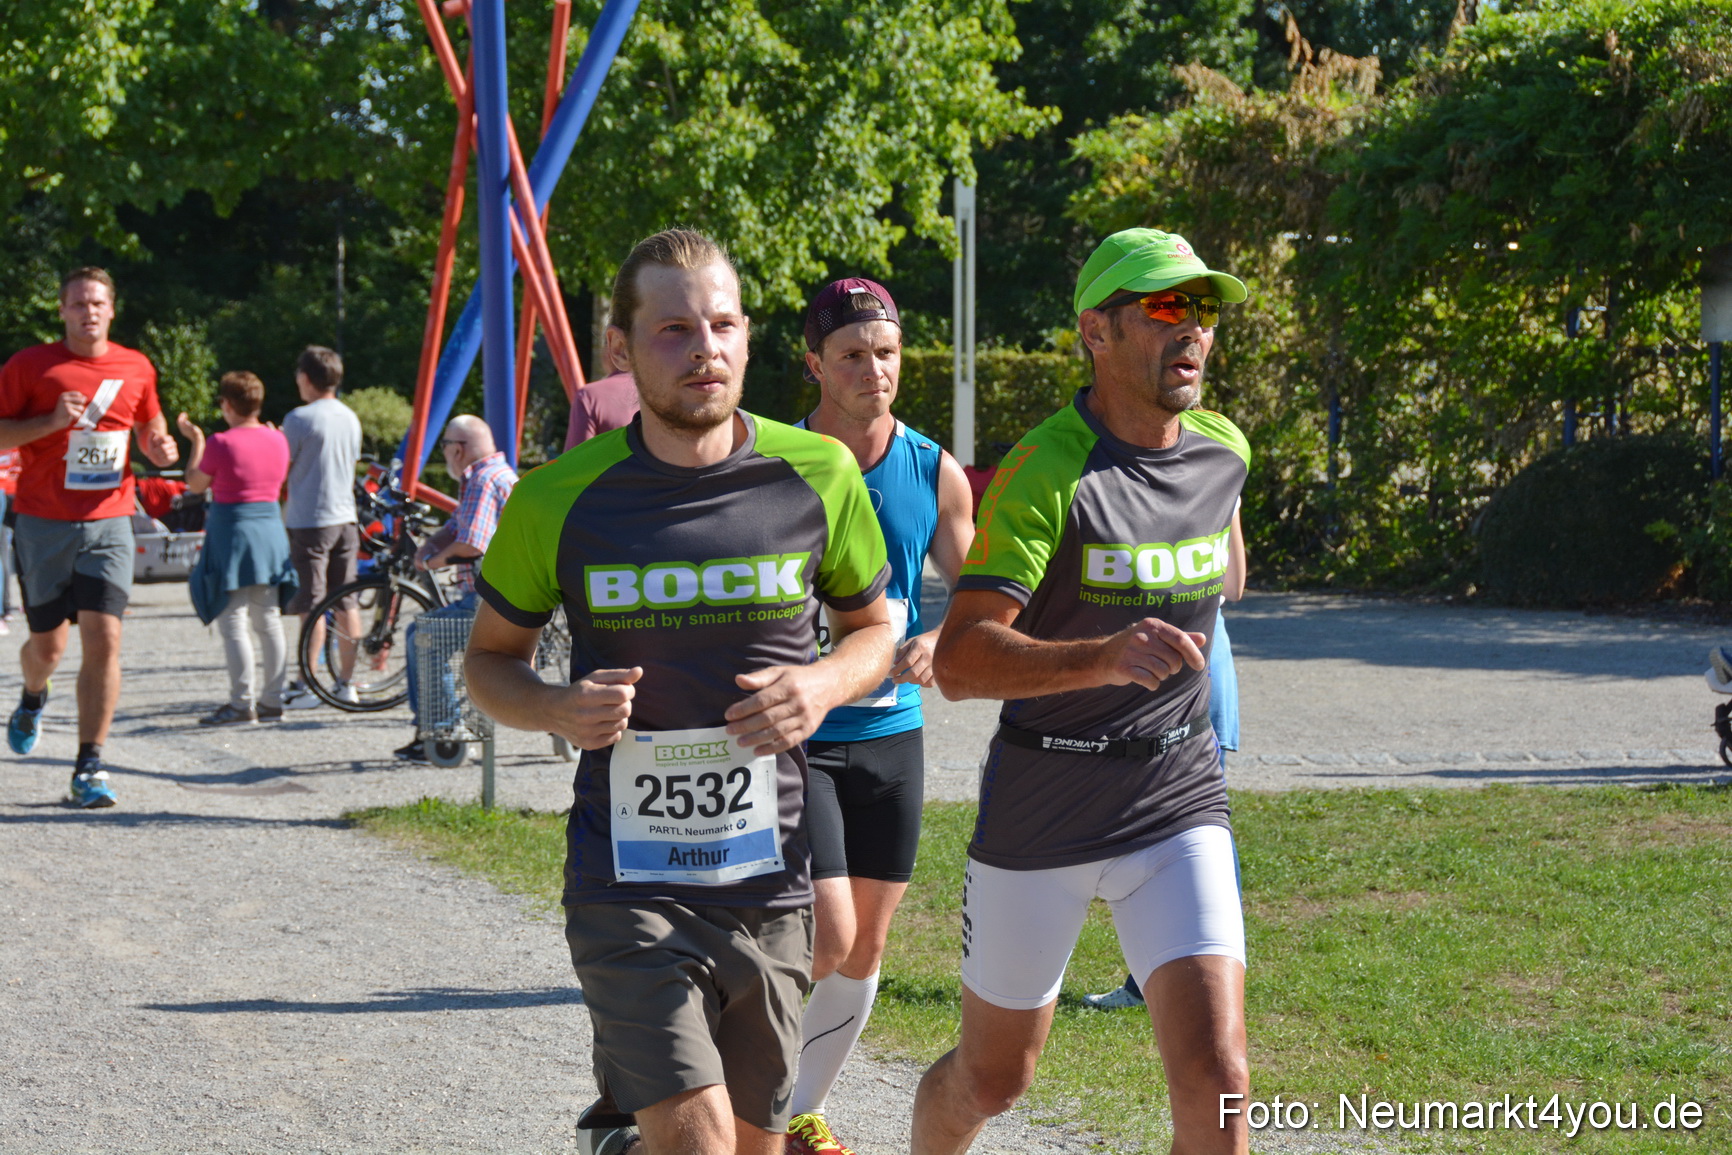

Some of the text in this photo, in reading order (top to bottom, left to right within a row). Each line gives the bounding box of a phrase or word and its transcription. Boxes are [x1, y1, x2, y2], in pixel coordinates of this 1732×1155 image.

[78, 447, 119, 465] 2614
[1082, 527, 1231, 588] BOCK
[585, 553, 810, 612] BOCK
[1079, 581, 1225, 608] inspired by smart con
[592, 603, 805, 632] inspired by smart concepts
[655, 740, 730, 761] BOCK
[1054, 737, 1091, 749] VIKING
[635, 766, 753, 820] 2532
[620, 806, 628, 816] A
[649, 824, 733, 836] PARTL Neumarkt
[668, 847, 730, 867] Arthur
